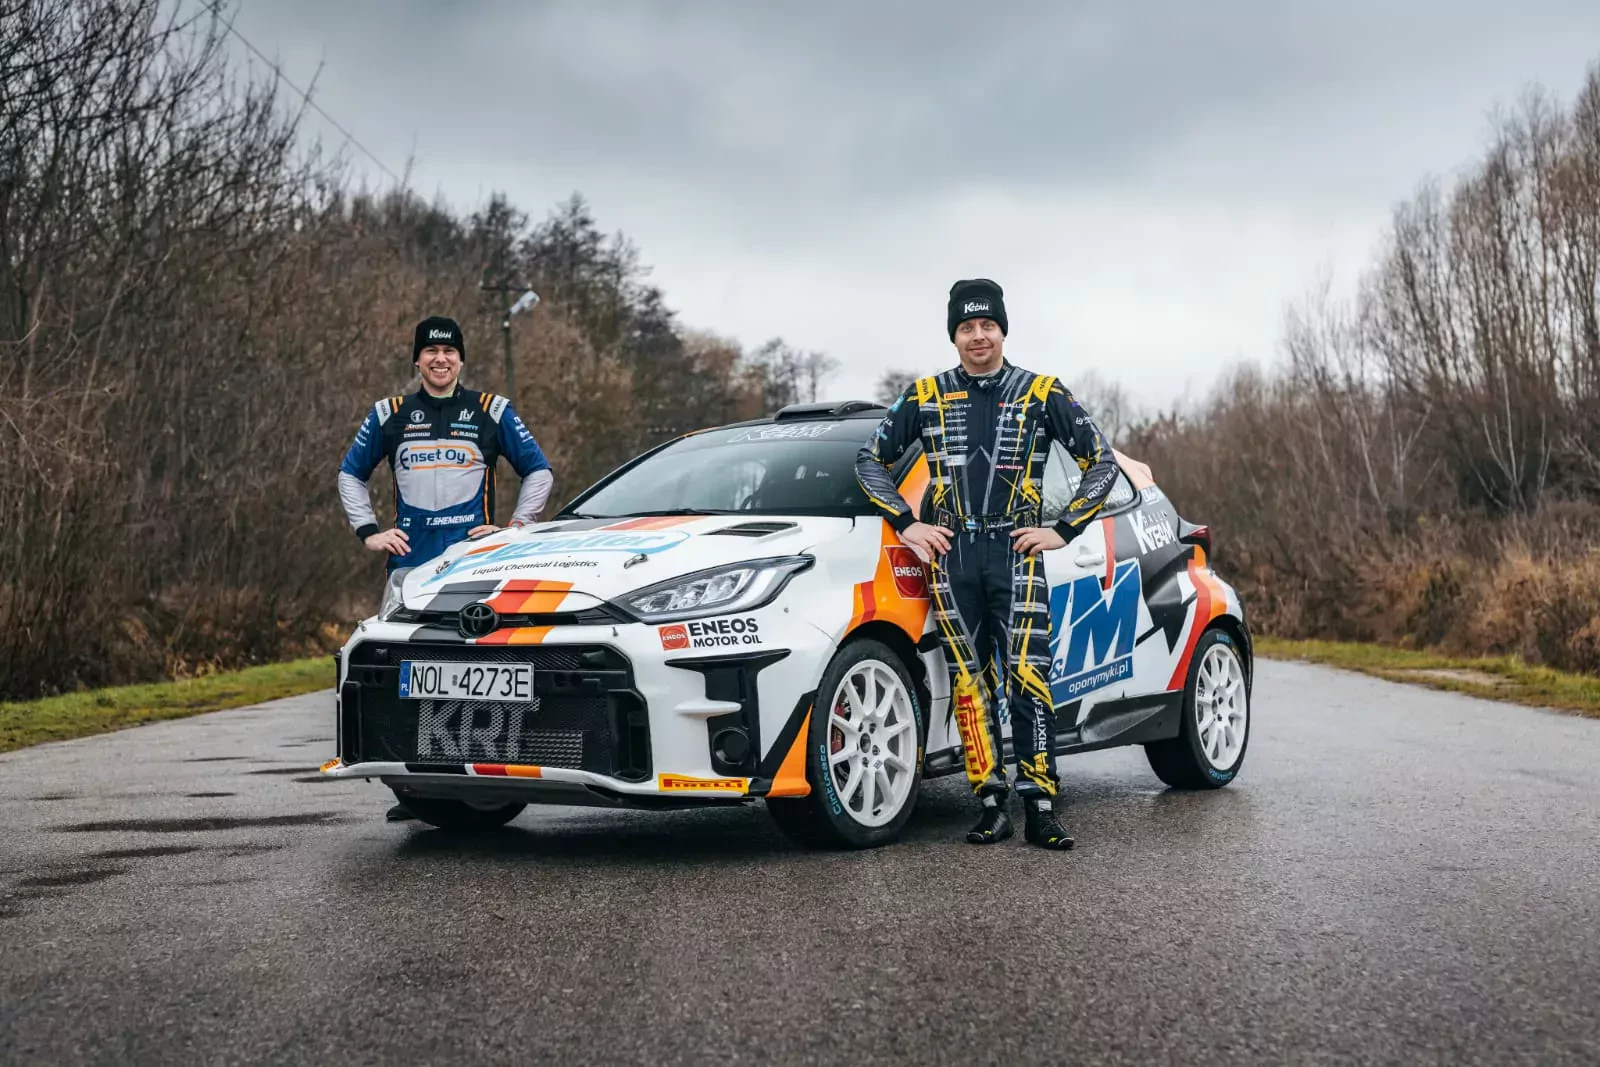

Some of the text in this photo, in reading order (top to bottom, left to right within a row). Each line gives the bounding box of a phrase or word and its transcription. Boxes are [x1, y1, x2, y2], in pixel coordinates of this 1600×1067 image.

[400, 448, 466, 470] Enset Oy
[472, 560, 600, 576] Liquid Chemical Logistics
[893, 566, 923, 577] ENEOS
[687, 617, 759, 637] ENEOS
[662, 633, 686, 641] ENEOS
[693, 634, 763, 648] MOTOR OIL
[410, 665, 529, 698] NOL 4273E
[1068, 660, 1129, 694] oponymyki.pl
[401, 683, 409, 691] PL
